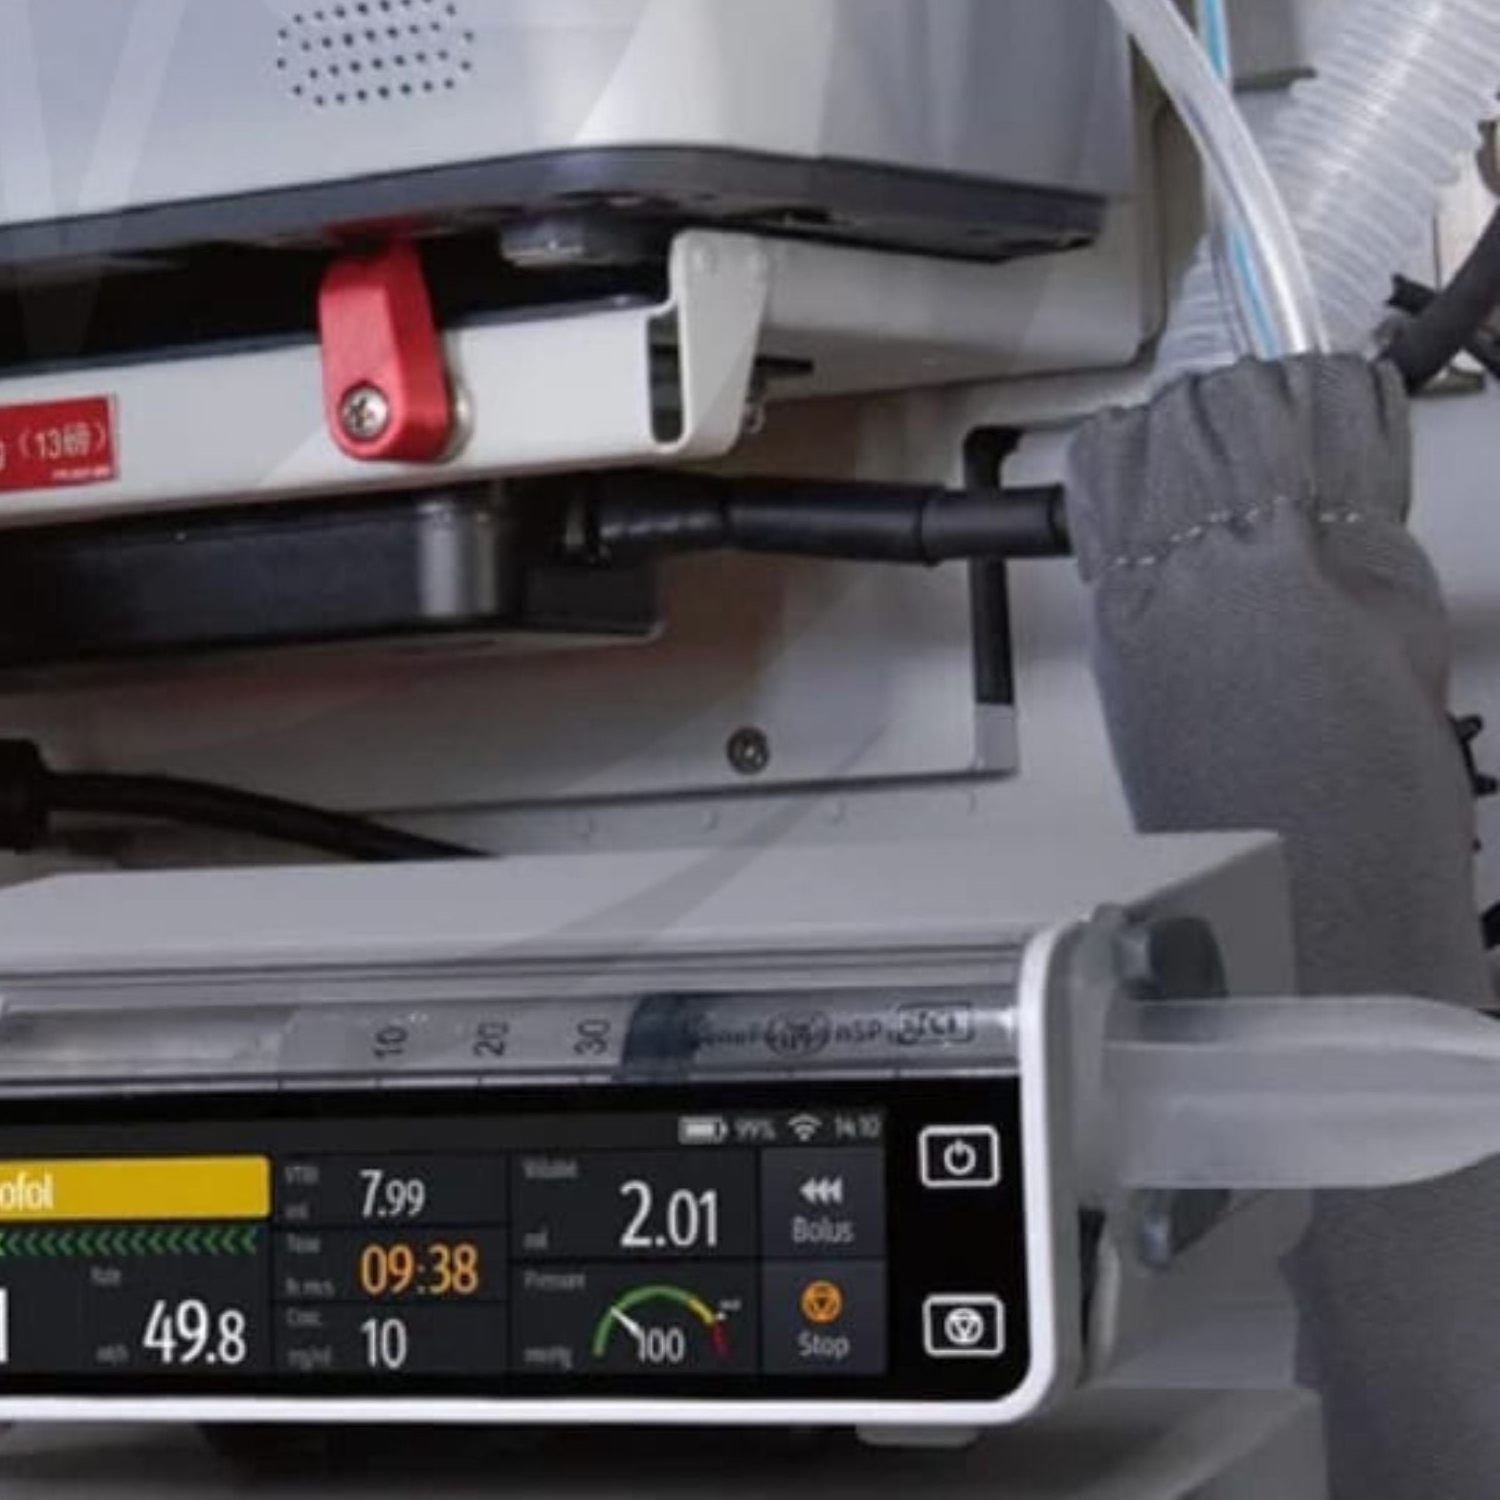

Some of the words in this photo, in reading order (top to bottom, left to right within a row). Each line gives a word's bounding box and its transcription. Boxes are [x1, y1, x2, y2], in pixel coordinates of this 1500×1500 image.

[374, 1025, 407, 1060] 10
[473, 1019, 509, 1058] 20
[573, 1018, 612, 1056] 30
[359, 1168, 427, 1219] 7.99
[618, 1179, 719, 1249] 2.01
[790, 1215, 856, 1245] Bolus
[358, 1239, 480, 1297] 09:38
[142, 1297, 248, 1366] 49.8
[360, 1316, 409, 1370] 10
[636, 1325, 687, 1364] 100
[796, 1328, 851, 1362] Stop
